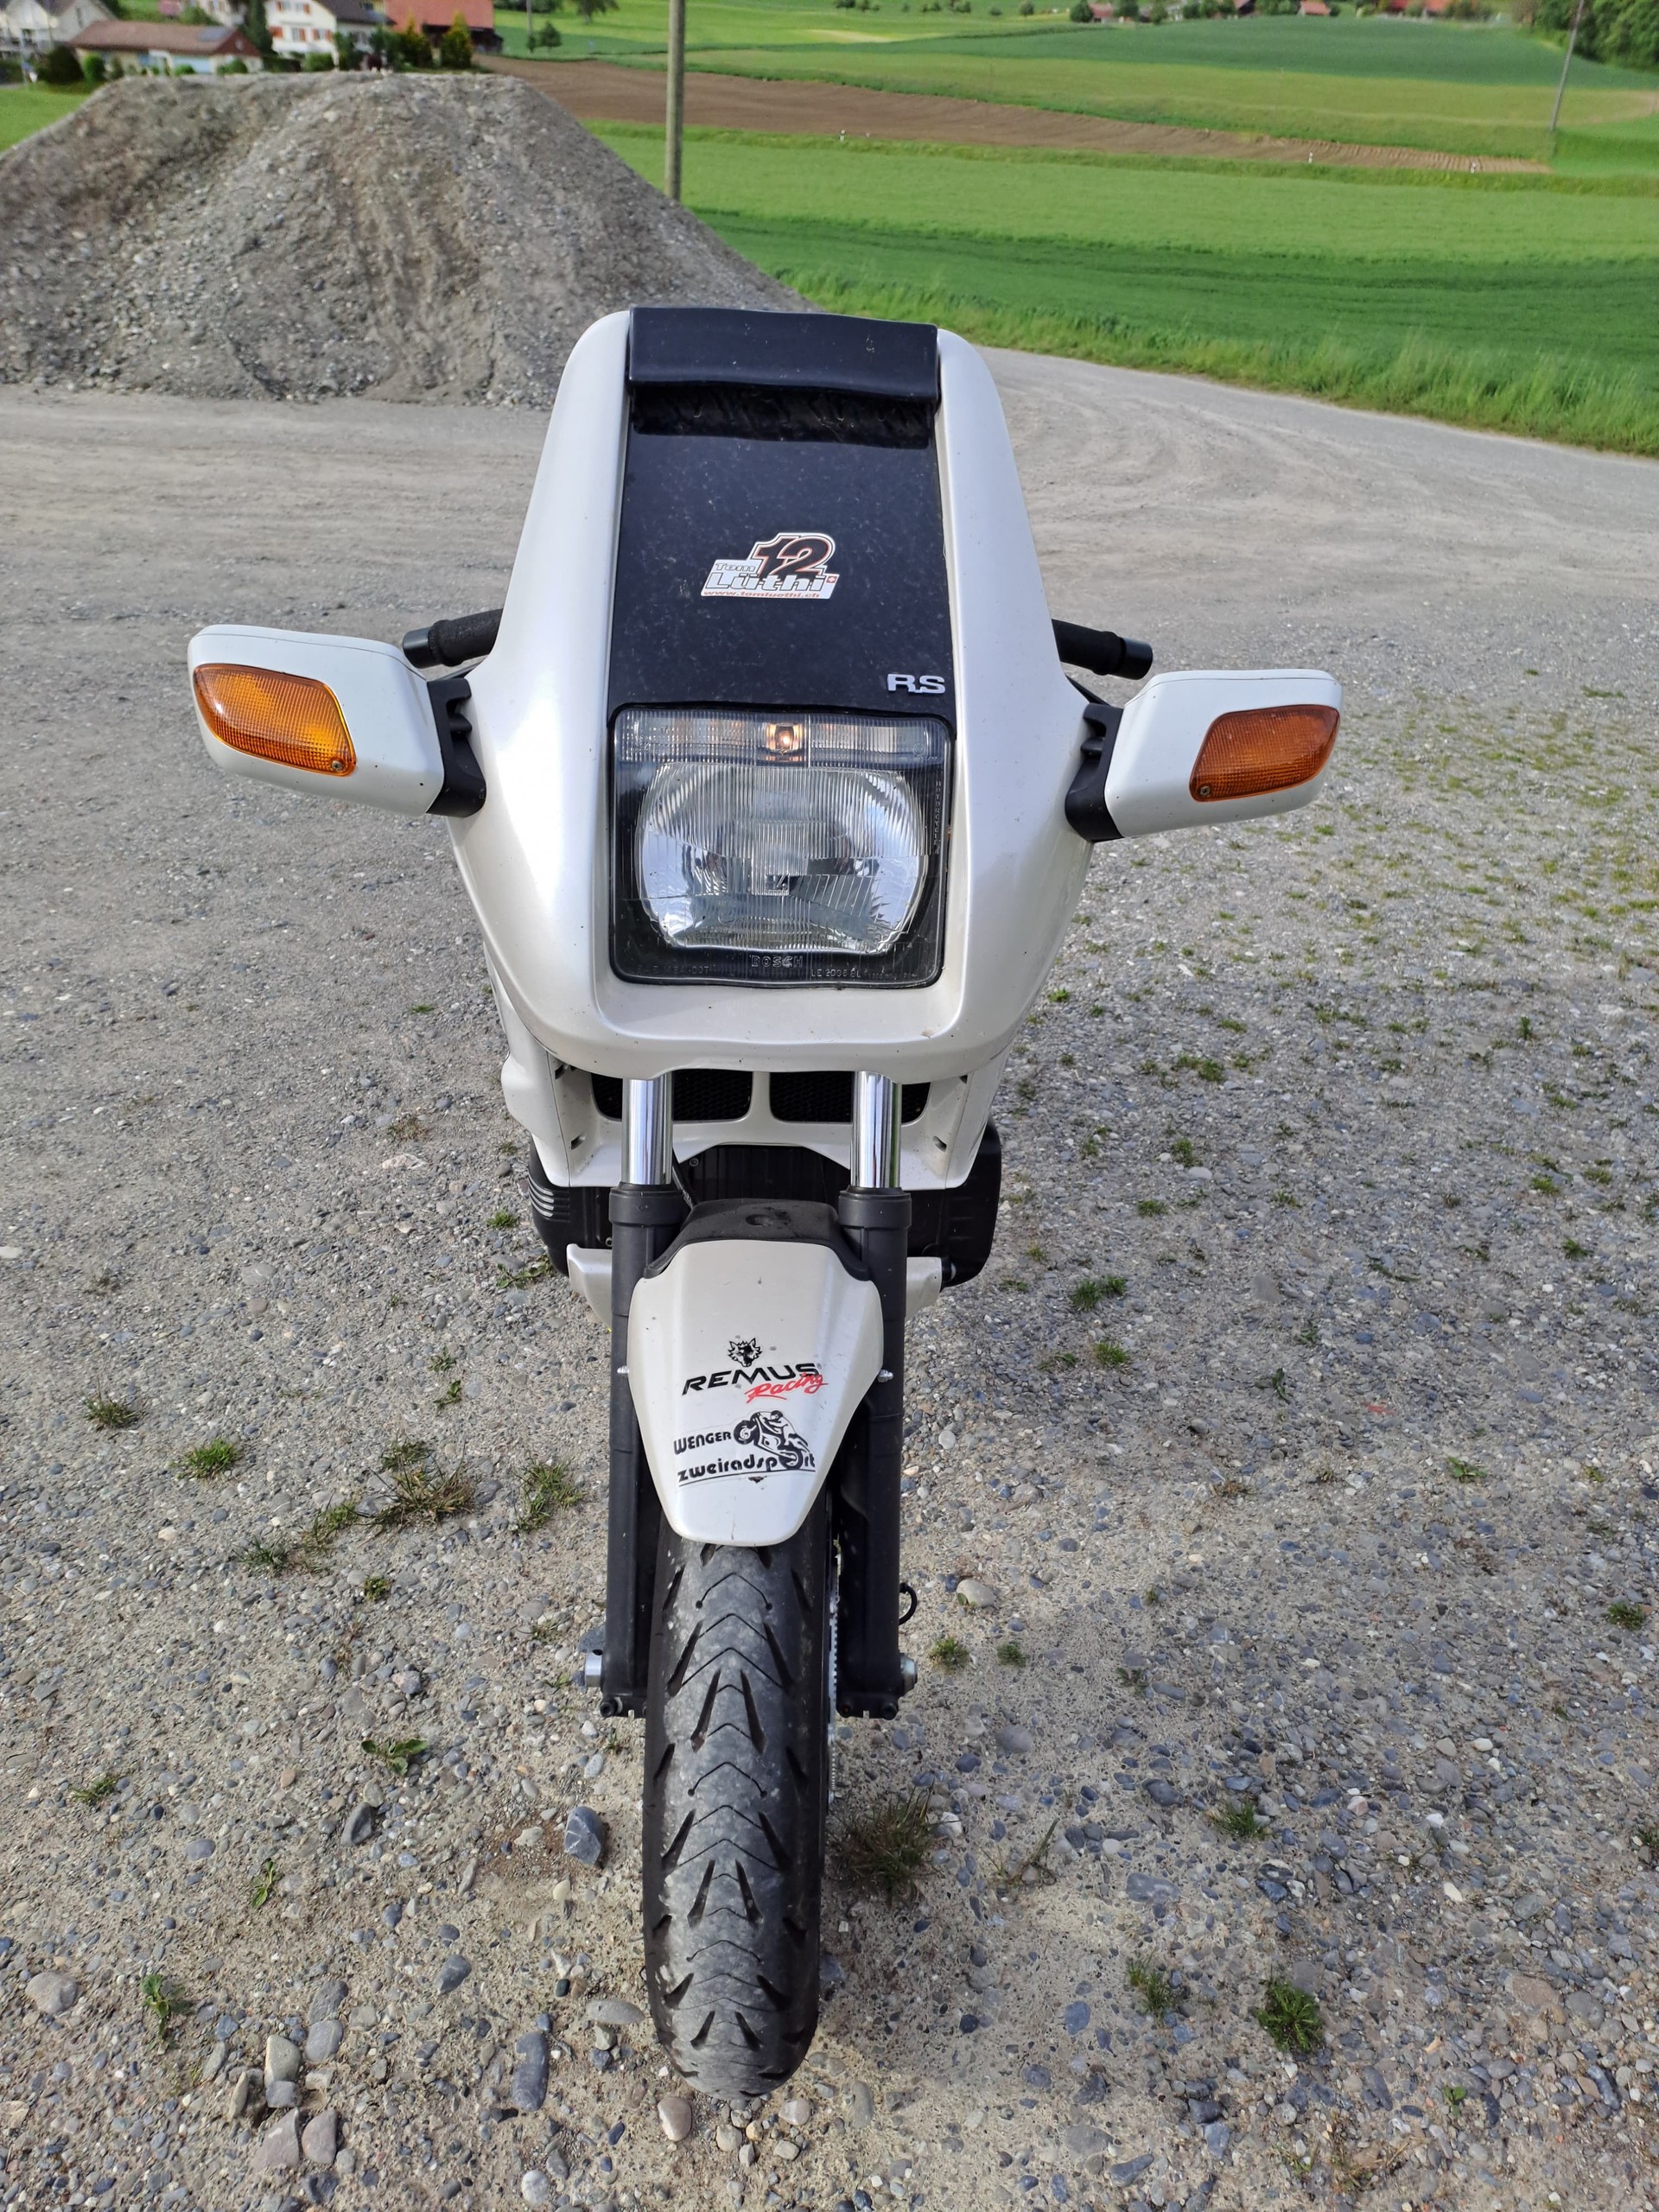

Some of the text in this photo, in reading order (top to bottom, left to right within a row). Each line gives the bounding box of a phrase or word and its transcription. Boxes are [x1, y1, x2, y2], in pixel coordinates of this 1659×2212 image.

[752, 534, 833, 577] 12
[715, 563, 756, 572] Tom
[705, 573, 826, 591] Lüthi
[887, 674, 945, 694] RS
[751, 955, 804, 968] BOSCH
[682, 1363, 821, 1396] REMUS
[744, 1372, 829, 1404] Racing
[673, 1431, 732, 1455] WENGER
